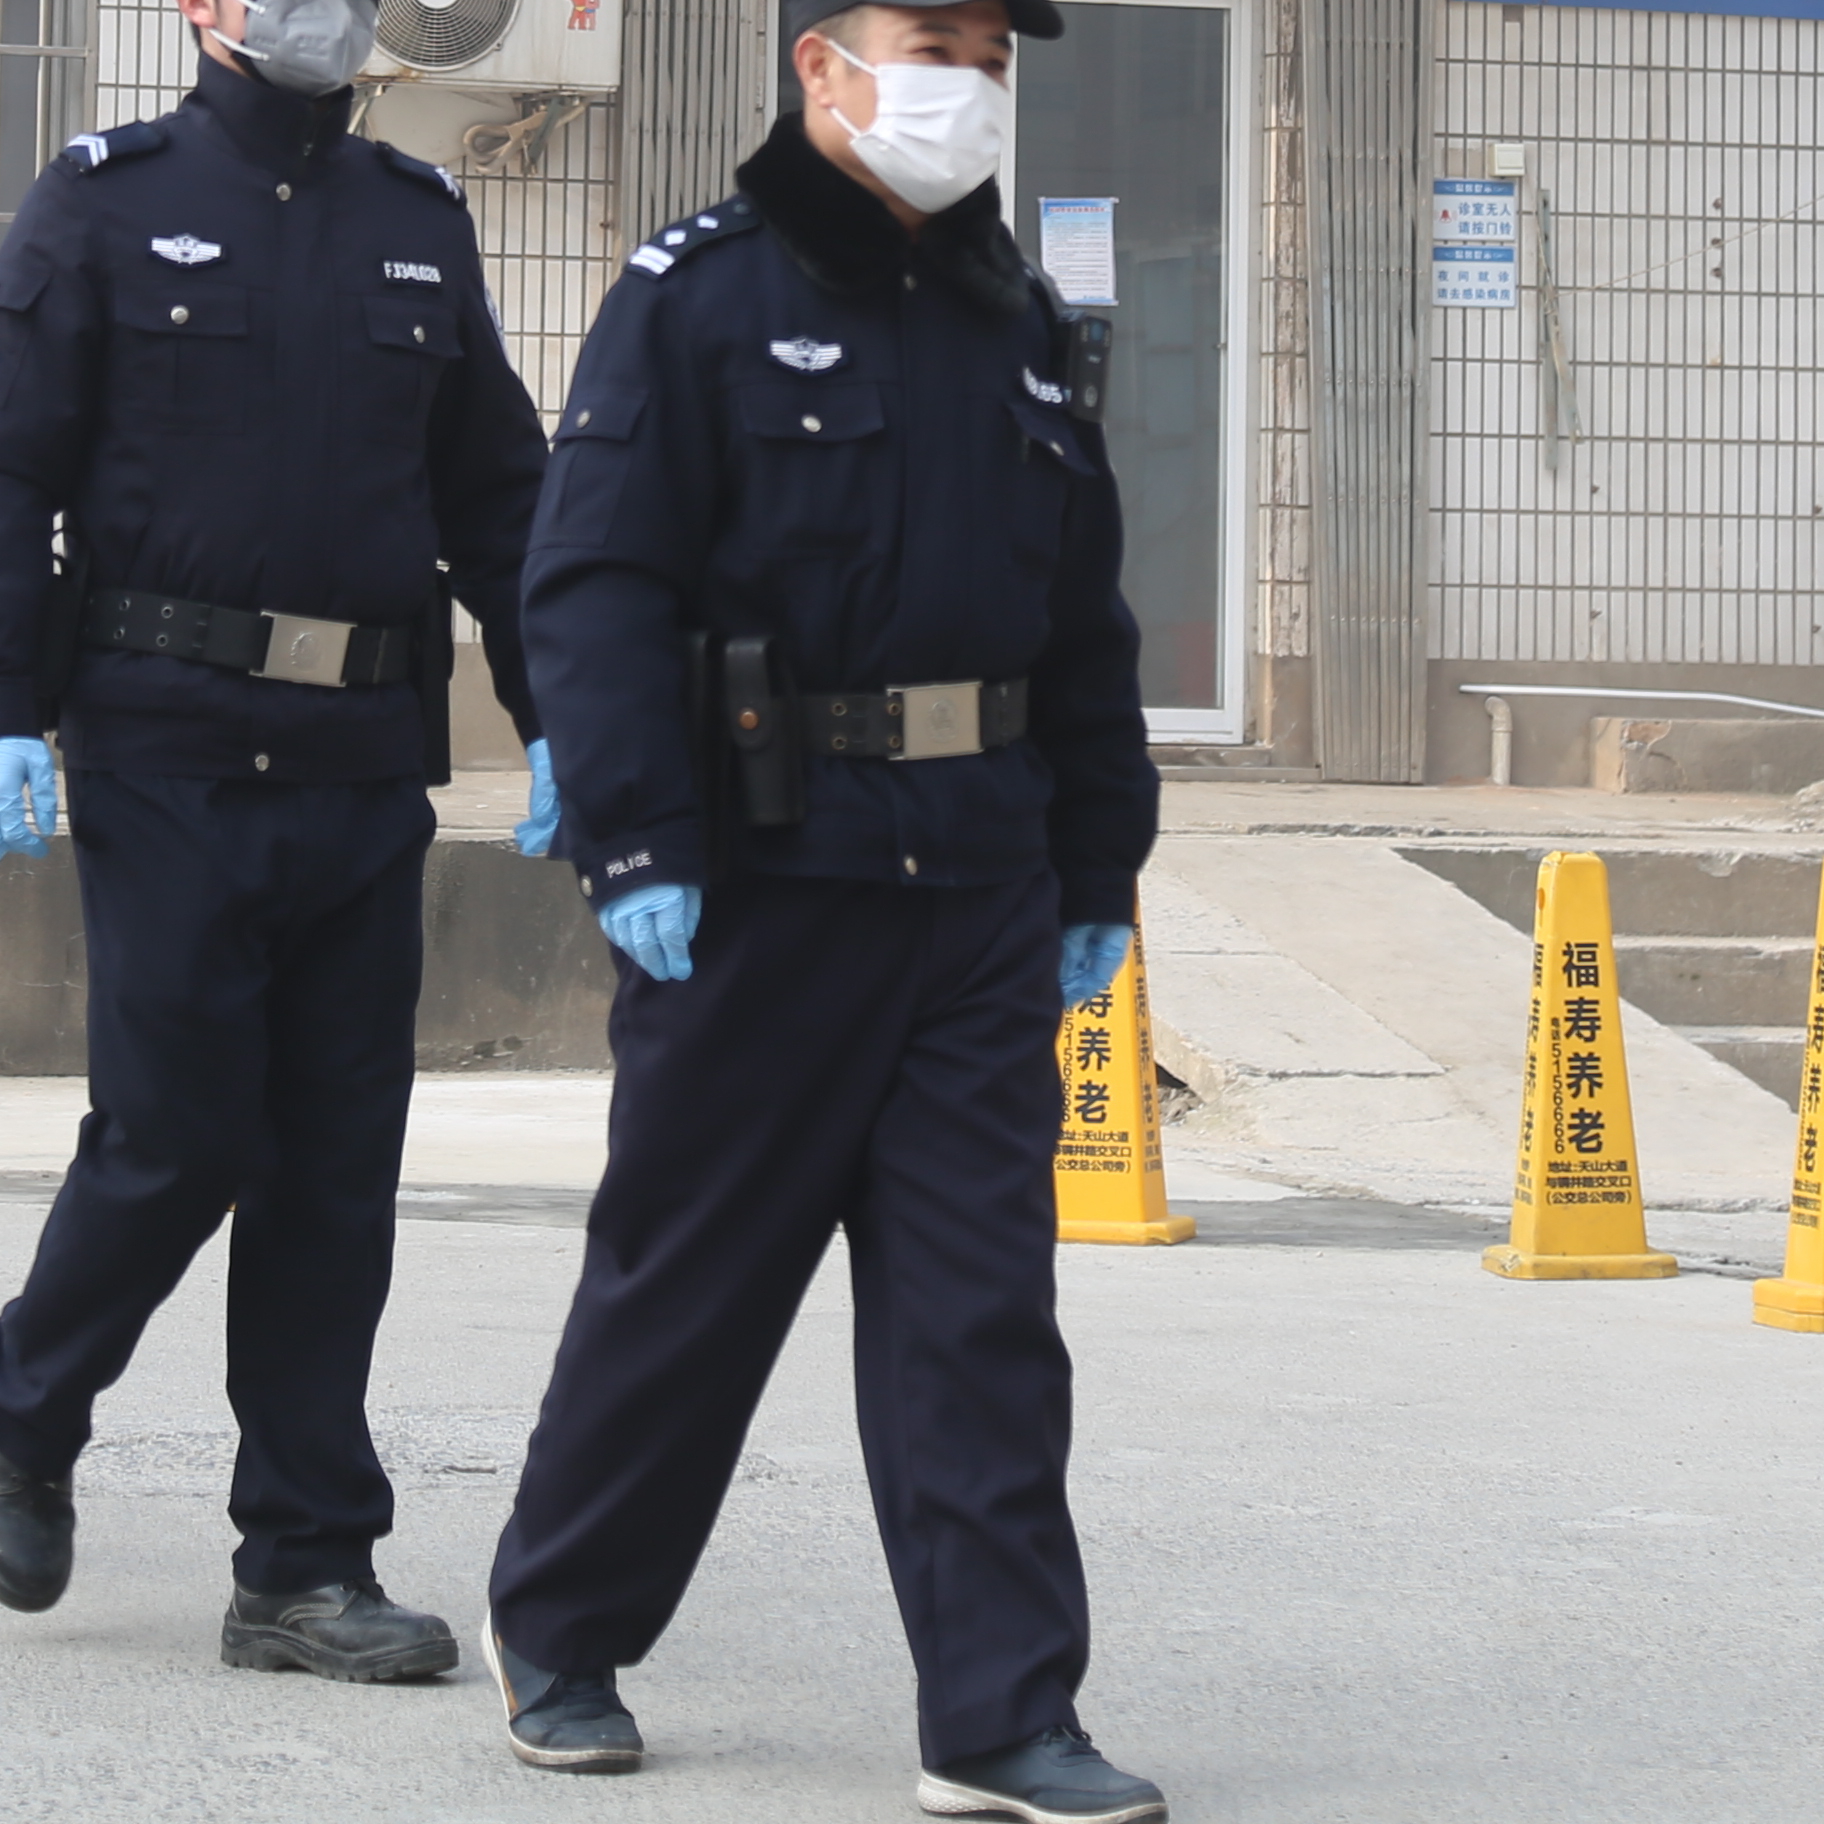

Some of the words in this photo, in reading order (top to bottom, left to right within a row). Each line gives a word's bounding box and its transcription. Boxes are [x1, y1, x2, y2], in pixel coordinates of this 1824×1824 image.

[1459, 202, 1511, 216] 诊室无人
[1459, 221, 1512, 235] 请按门铃
[606, 853, 652, 878] POLICE
[1075, 981, 1114, 1125] 寿养老
[1562, 941, 1605, 1156] 福寿养老
